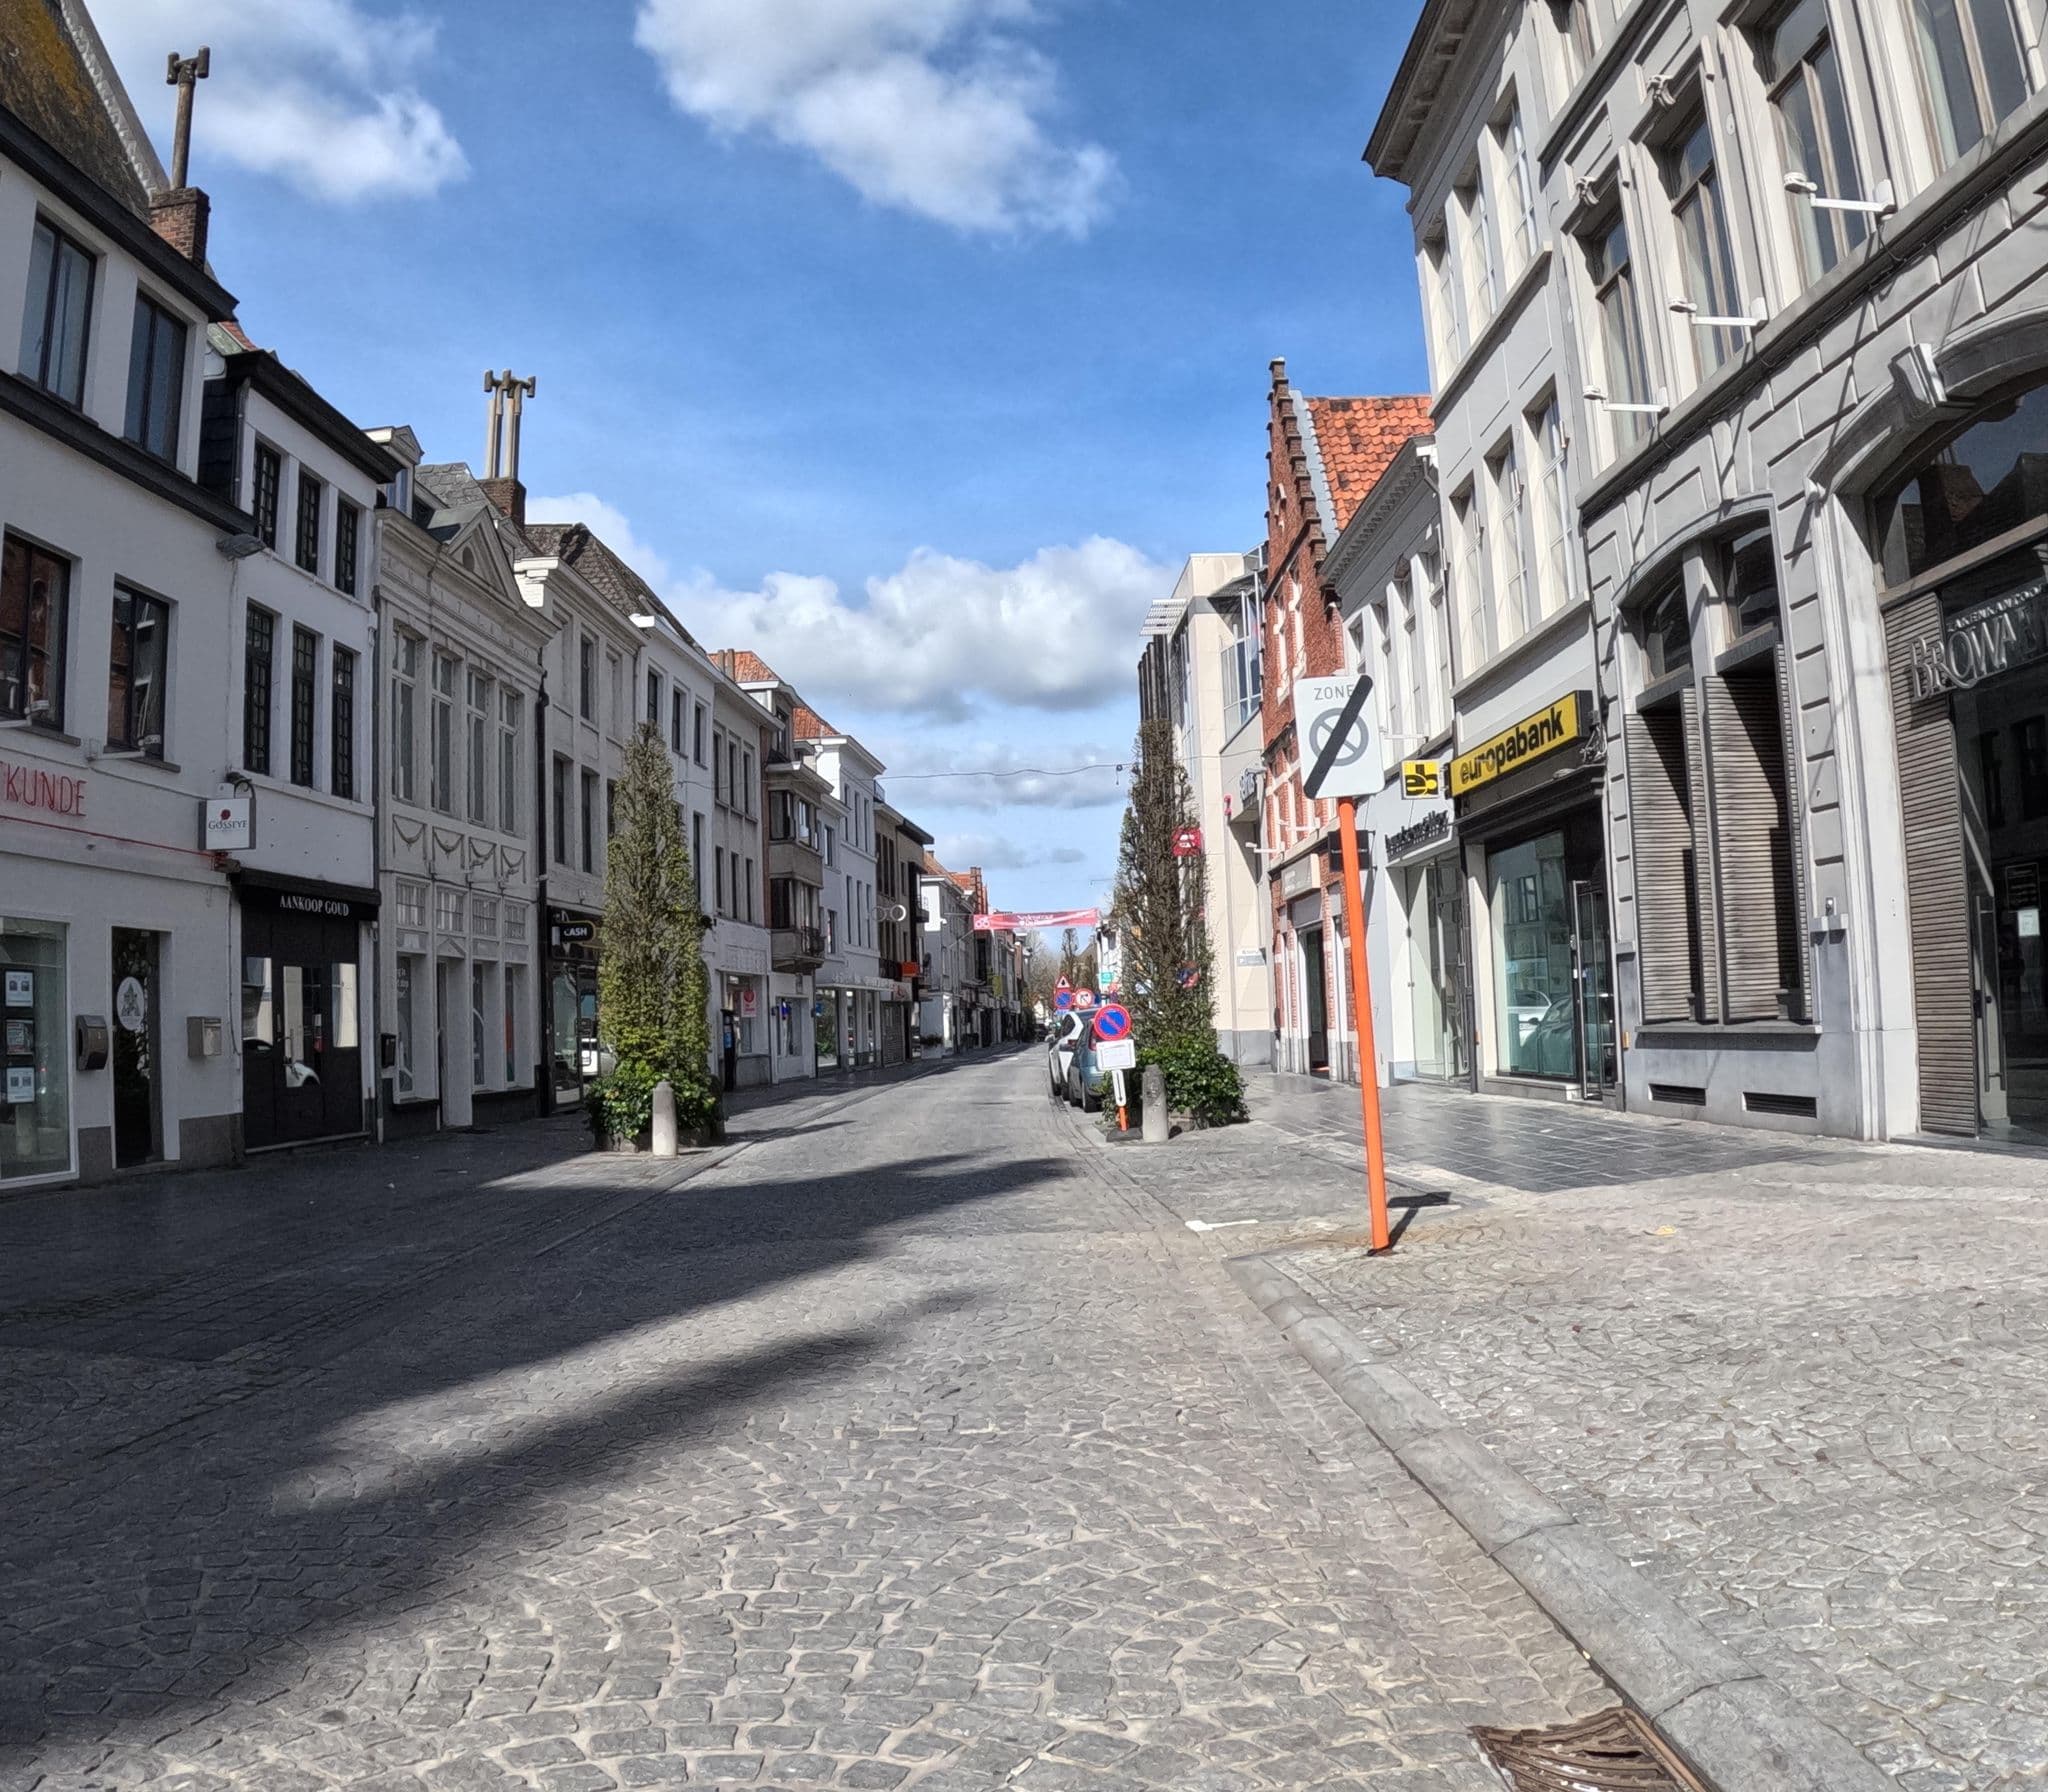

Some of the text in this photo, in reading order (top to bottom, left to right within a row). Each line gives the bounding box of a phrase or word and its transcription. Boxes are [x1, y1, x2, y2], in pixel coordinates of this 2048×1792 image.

[1313, 684, 1354, 700] ZONE
[1459, 706, 1564, 785] europabank
[0, 760, 88, 817] KUNDE
[280, 896, 349, 916] AANKOOP GOUD
[563, 927, 588, 937] CASH
